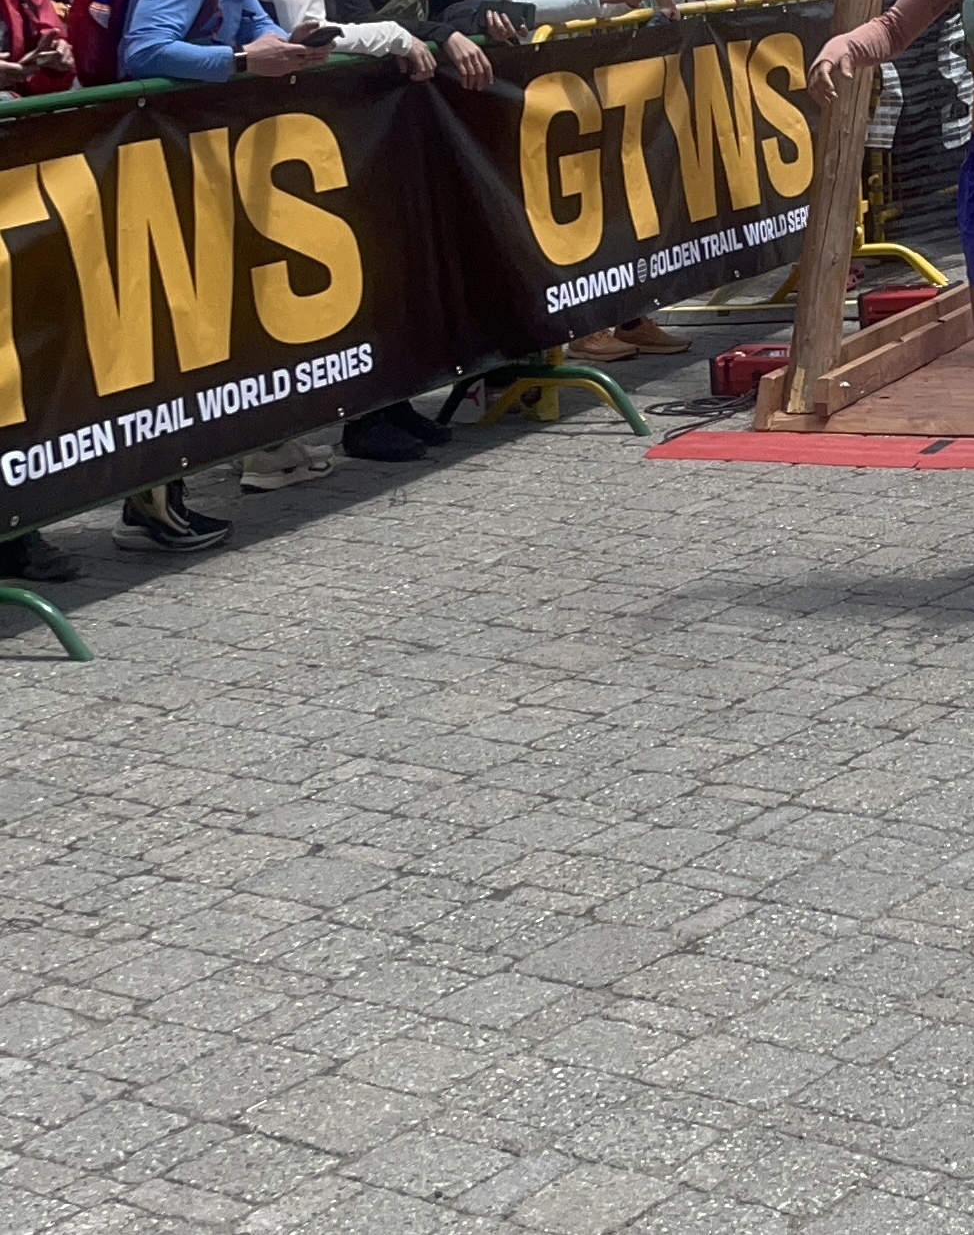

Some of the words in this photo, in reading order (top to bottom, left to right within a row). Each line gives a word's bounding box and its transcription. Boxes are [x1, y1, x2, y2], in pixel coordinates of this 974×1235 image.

[520, 32, 814, 265] GTWS
[0, 112, 363, 428] WS
[546, 262, 634, 314] SALOMON
[650, 239, 700, 278] GOLDEN
[701, 229, 743, 261] TRAIL
[743, 213, 787, 247] WORLD
[788, 205, 810, 233] SER
[1, 424, 116, 487] GOLDEN
[118, 396, 194, 447] TRAIL
[197, 368, 292, 422] WORLD
[295, 343, 374, 393] SERIES
